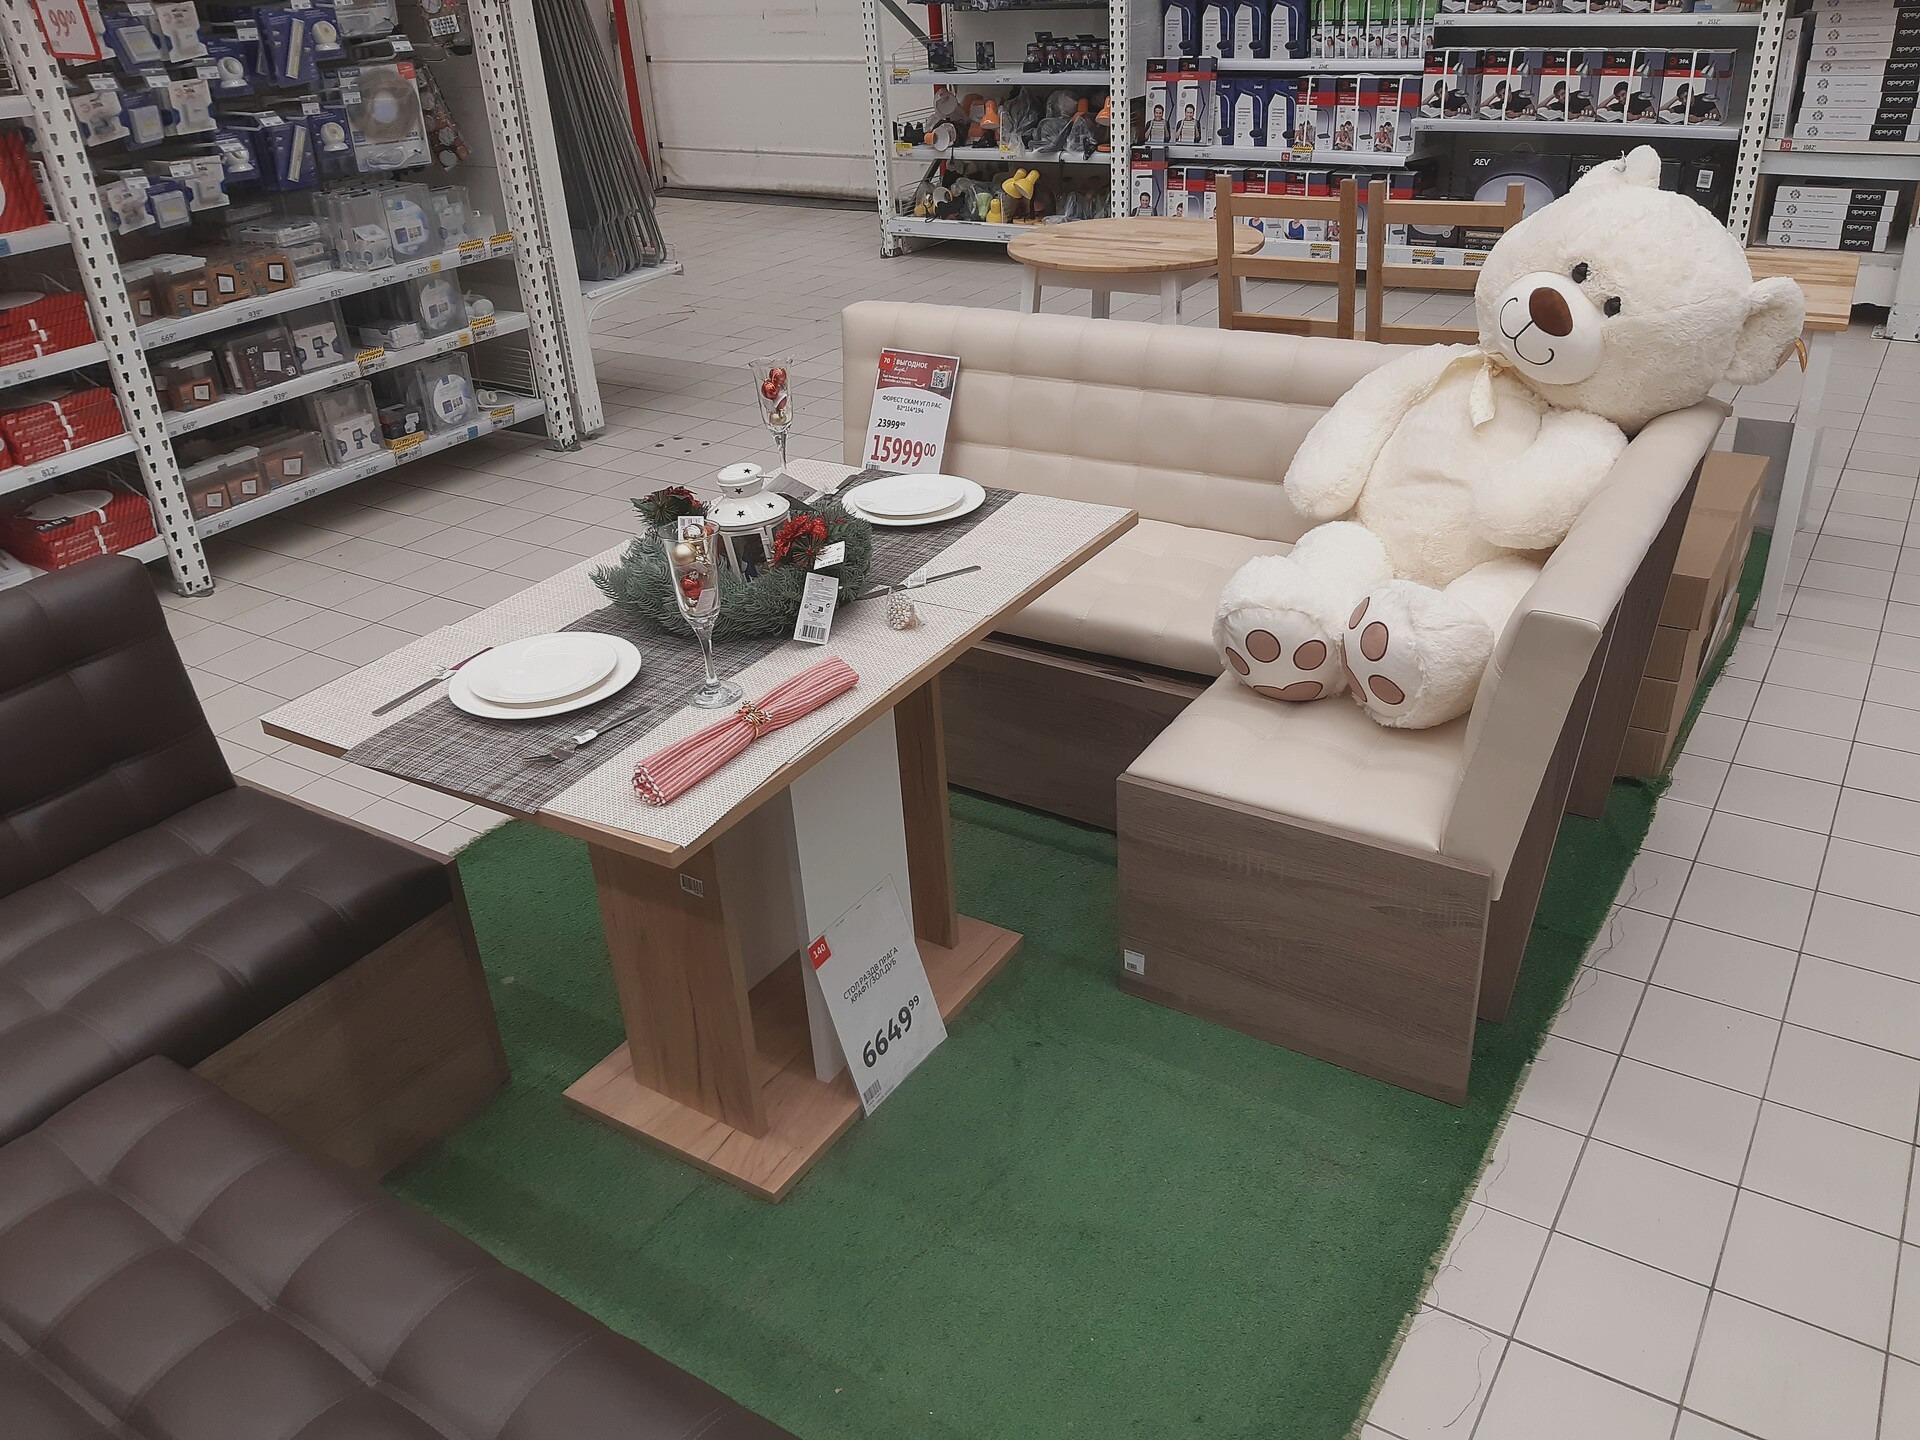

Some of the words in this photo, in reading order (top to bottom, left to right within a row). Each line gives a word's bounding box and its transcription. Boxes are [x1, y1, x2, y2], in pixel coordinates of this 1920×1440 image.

[1890, 62, 1918, 70] apeyron
[1887, 79, 1915, 87] apeyron
[1473, 158, 1491, 166] REV
[1855, 193, 1881, 201] apeyron
[1846, 224, 1872, 232] apeyron
[1844, 239, 1869, 247] apeyron
[896, 359, 929, 369] ВЫГОДНОЕ
[812, 943, 826, 959] 140
[843, 981, 860, 1000] СТОЛ
[879, 946, 899, 967] ПРАГА
